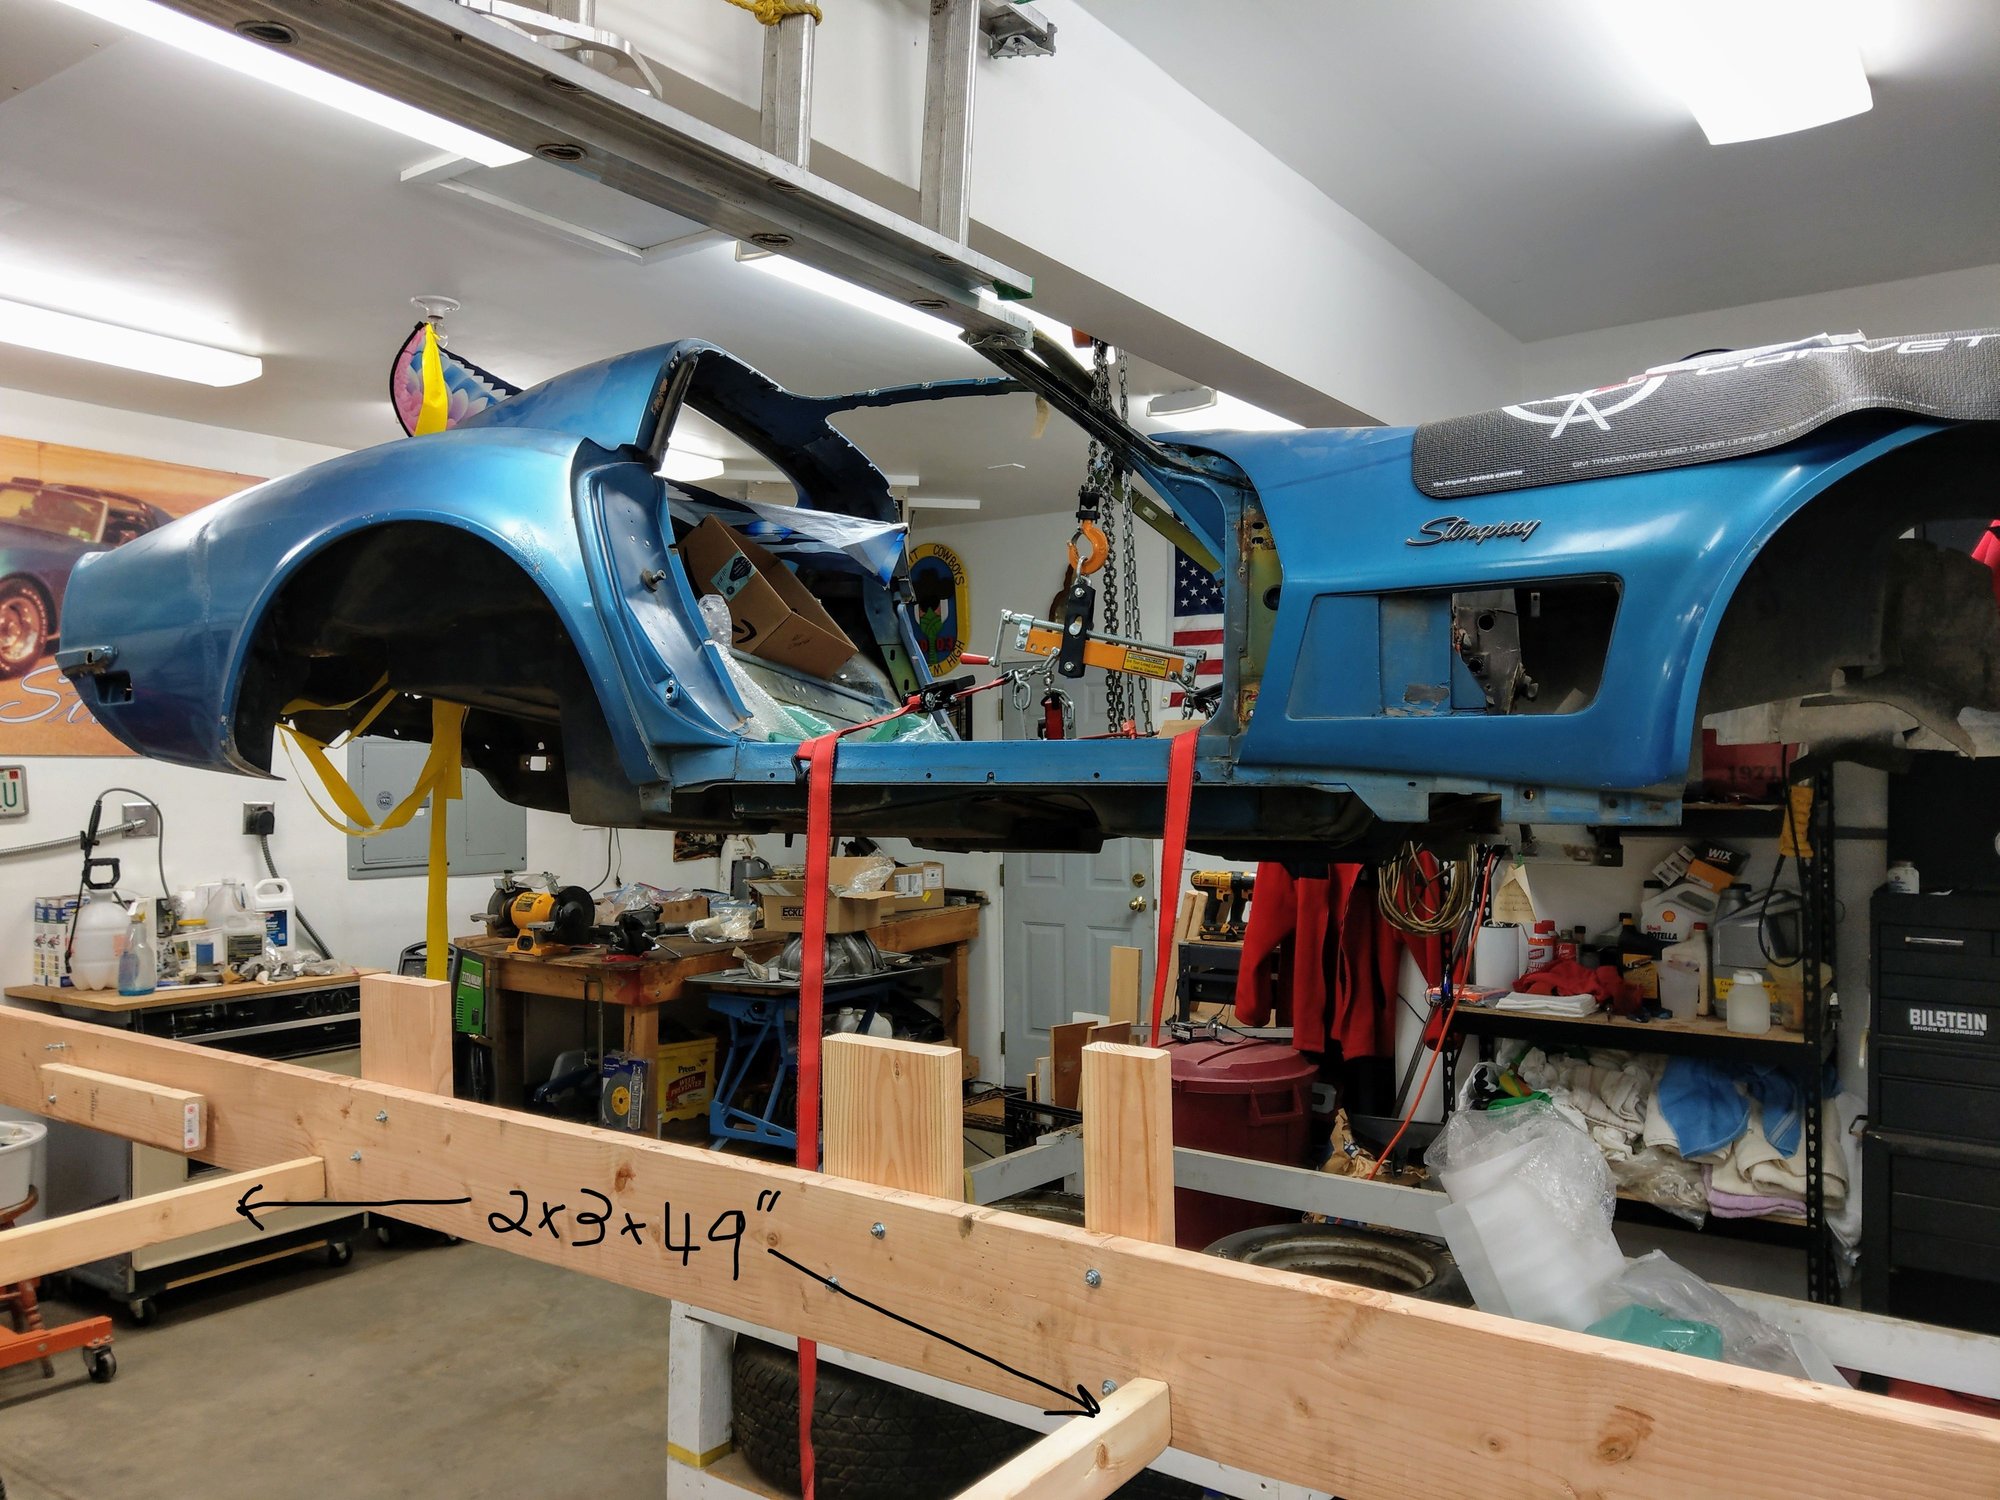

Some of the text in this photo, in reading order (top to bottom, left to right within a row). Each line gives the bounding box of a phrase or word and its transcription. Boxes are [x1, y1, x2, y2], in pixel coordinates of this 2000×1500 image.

[1592, 450, 1658, 466] TRADEMARKS
[1660, 446, 1688, 457] USED
[1690, 440, 1725, 454] UNDER
[1406, 515, 1542, 547] Stingray
[933, 544, 965, 586] COWBOYS
[946, 640, 966, 668] HIGH
[1708, 848, 1733, 860] WIX
[782, 907, 803, 917] ECKL
[1909, 1008, 1988, 1031] BILSTEIN
[1912, 1025, 1985, 1037] SHOCK ABSORBERS
[678, 1065, 696, 1074] Preen
[679, 1075, 696, 1086] WEED
